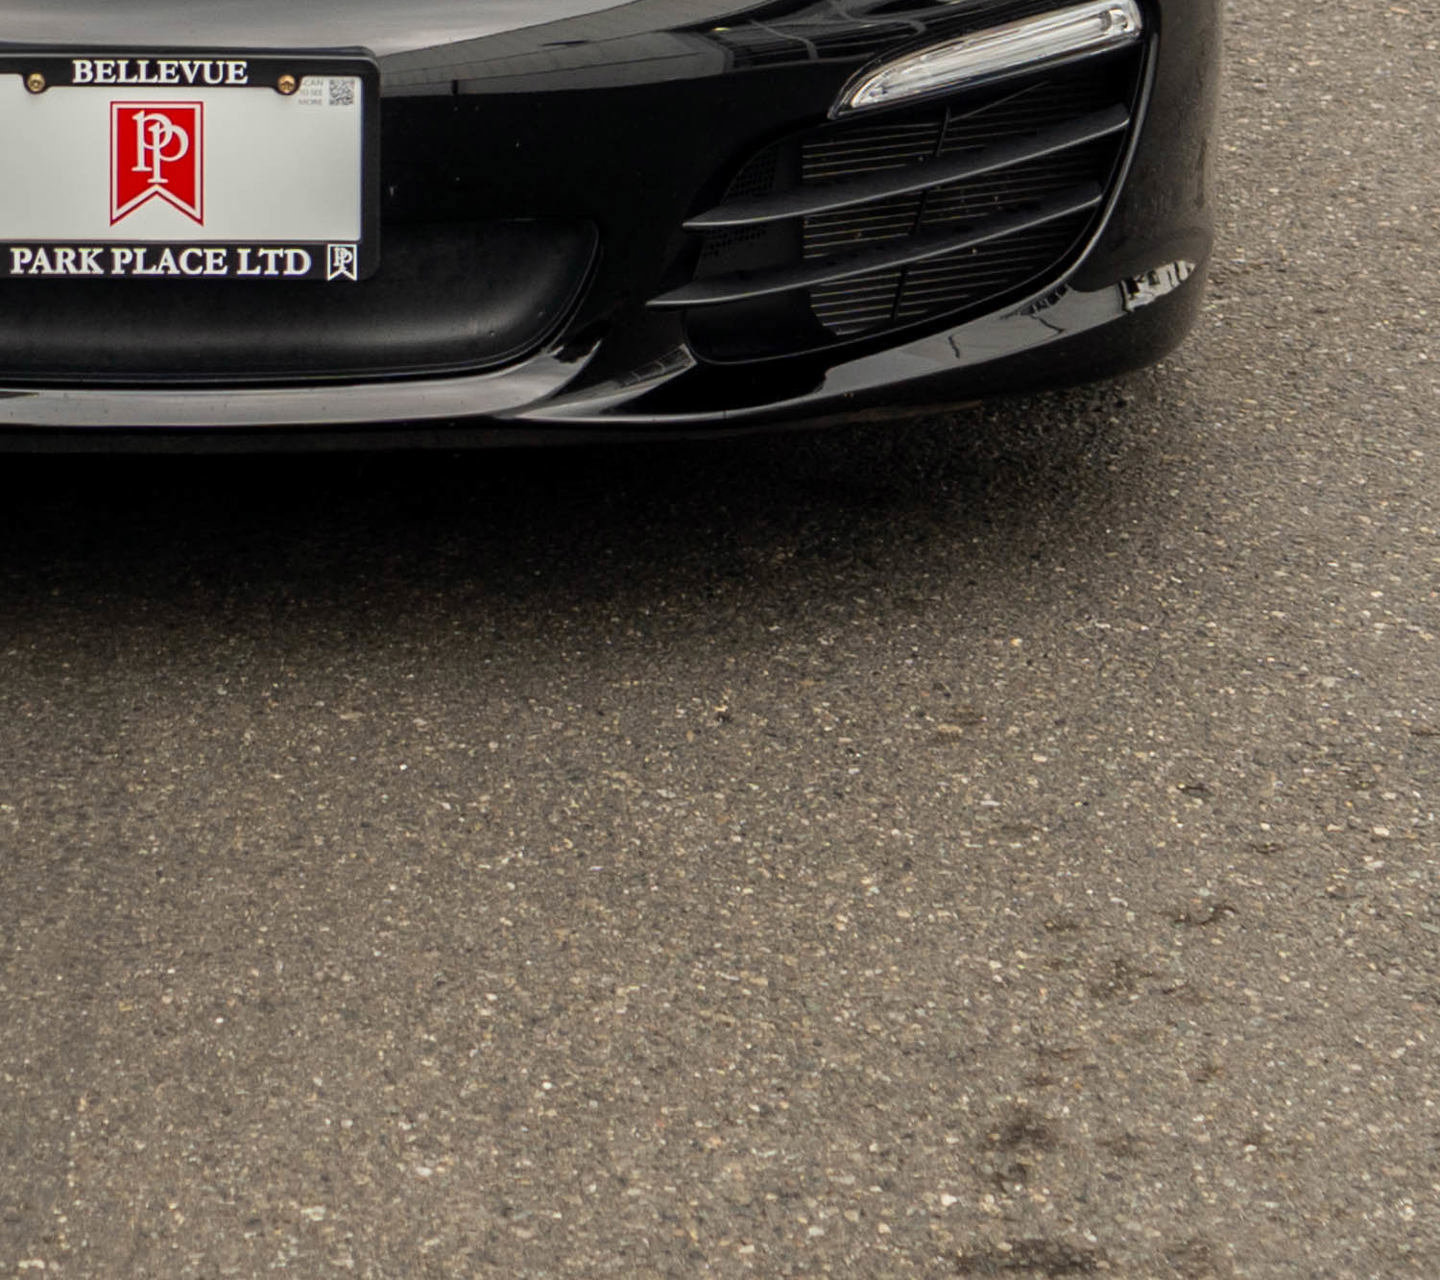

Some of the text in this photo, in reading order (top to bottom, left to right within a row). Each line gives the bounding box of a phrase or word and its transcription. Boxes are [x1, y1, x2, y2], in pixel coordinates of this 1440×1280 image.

[72, 59, 249, 85] BELLEVUE
[302, 79, 324, 87] CAN
[10, 247, 312, 276] PARK PLACE LTD
